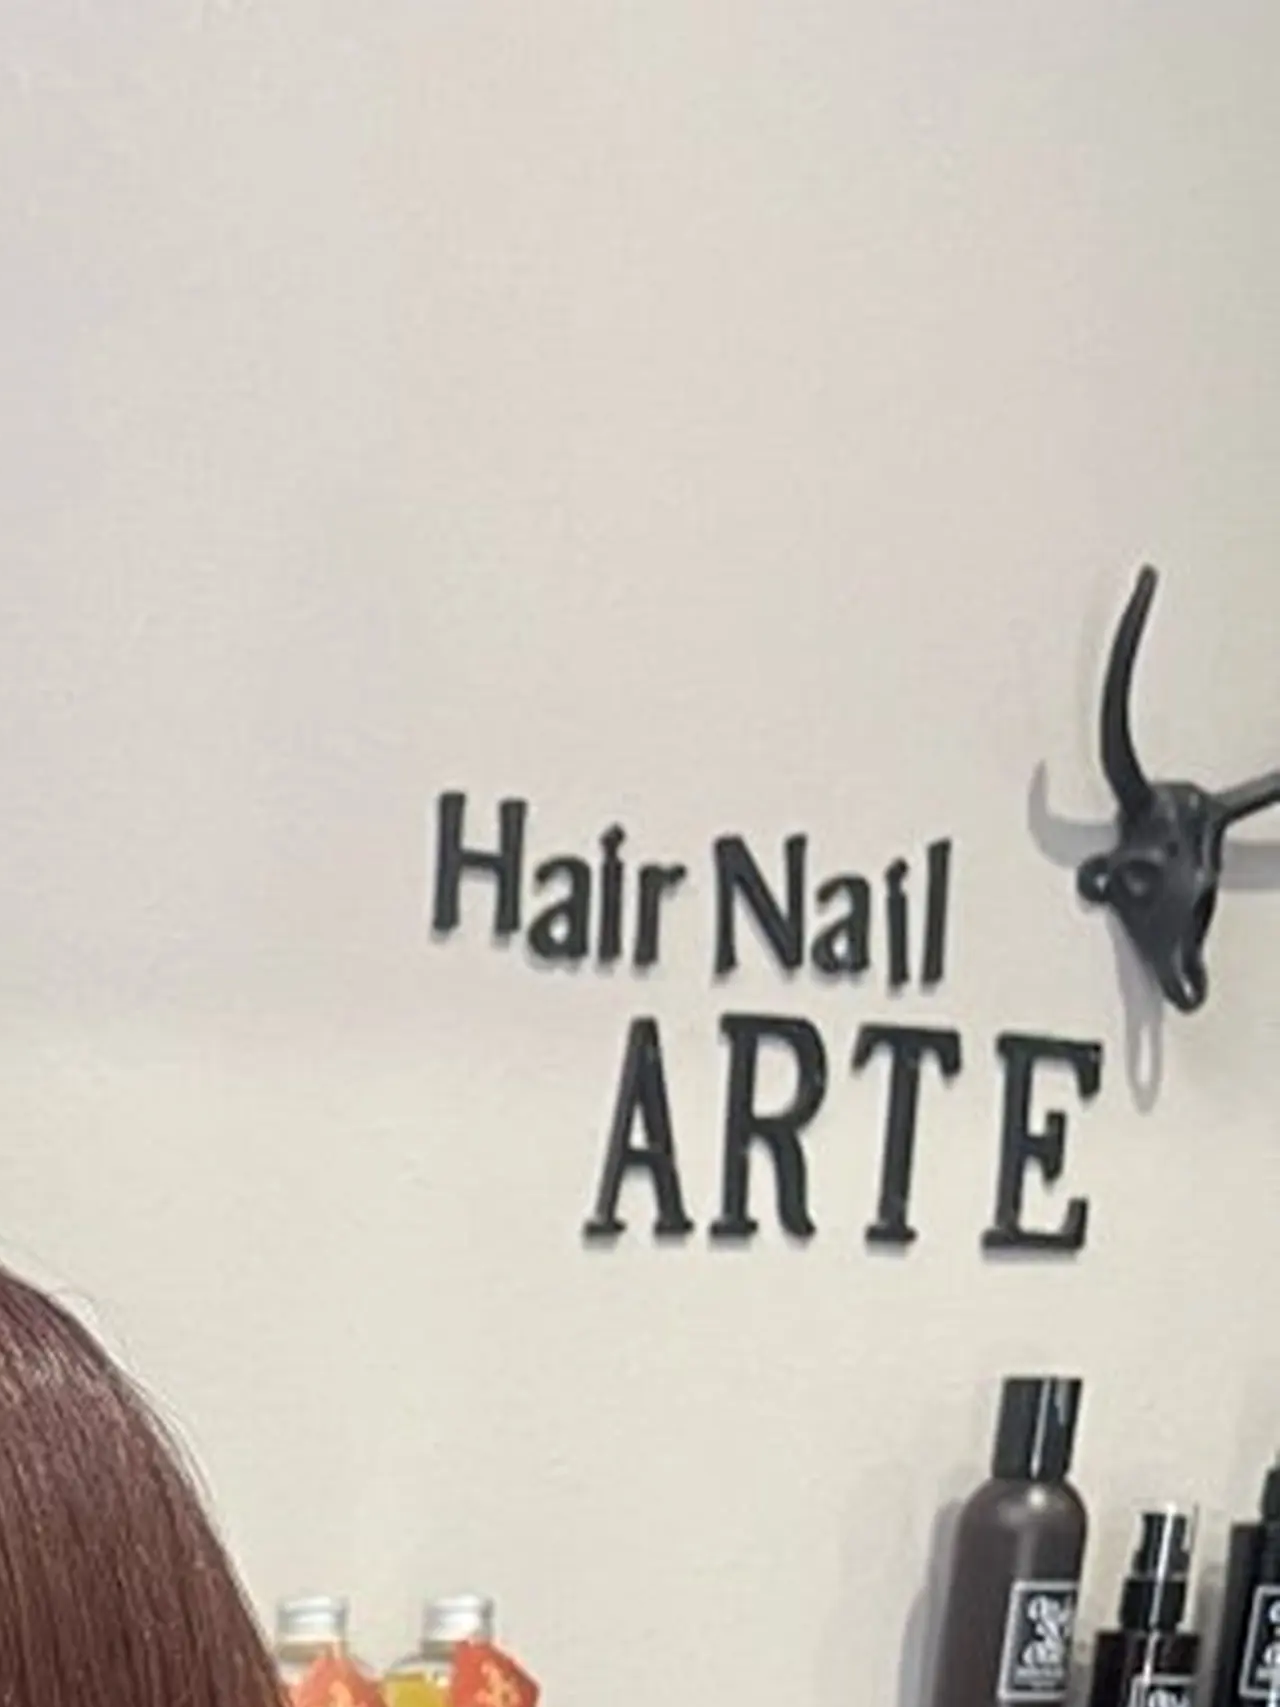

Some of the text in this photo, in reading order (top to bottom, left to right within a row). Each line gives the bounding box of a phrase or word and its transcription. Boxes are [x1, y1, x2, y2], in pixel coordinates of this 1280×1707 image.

[432, 792, 952, 989] Hair Nail
[583, 1013, 1104, 1254] ARTE
